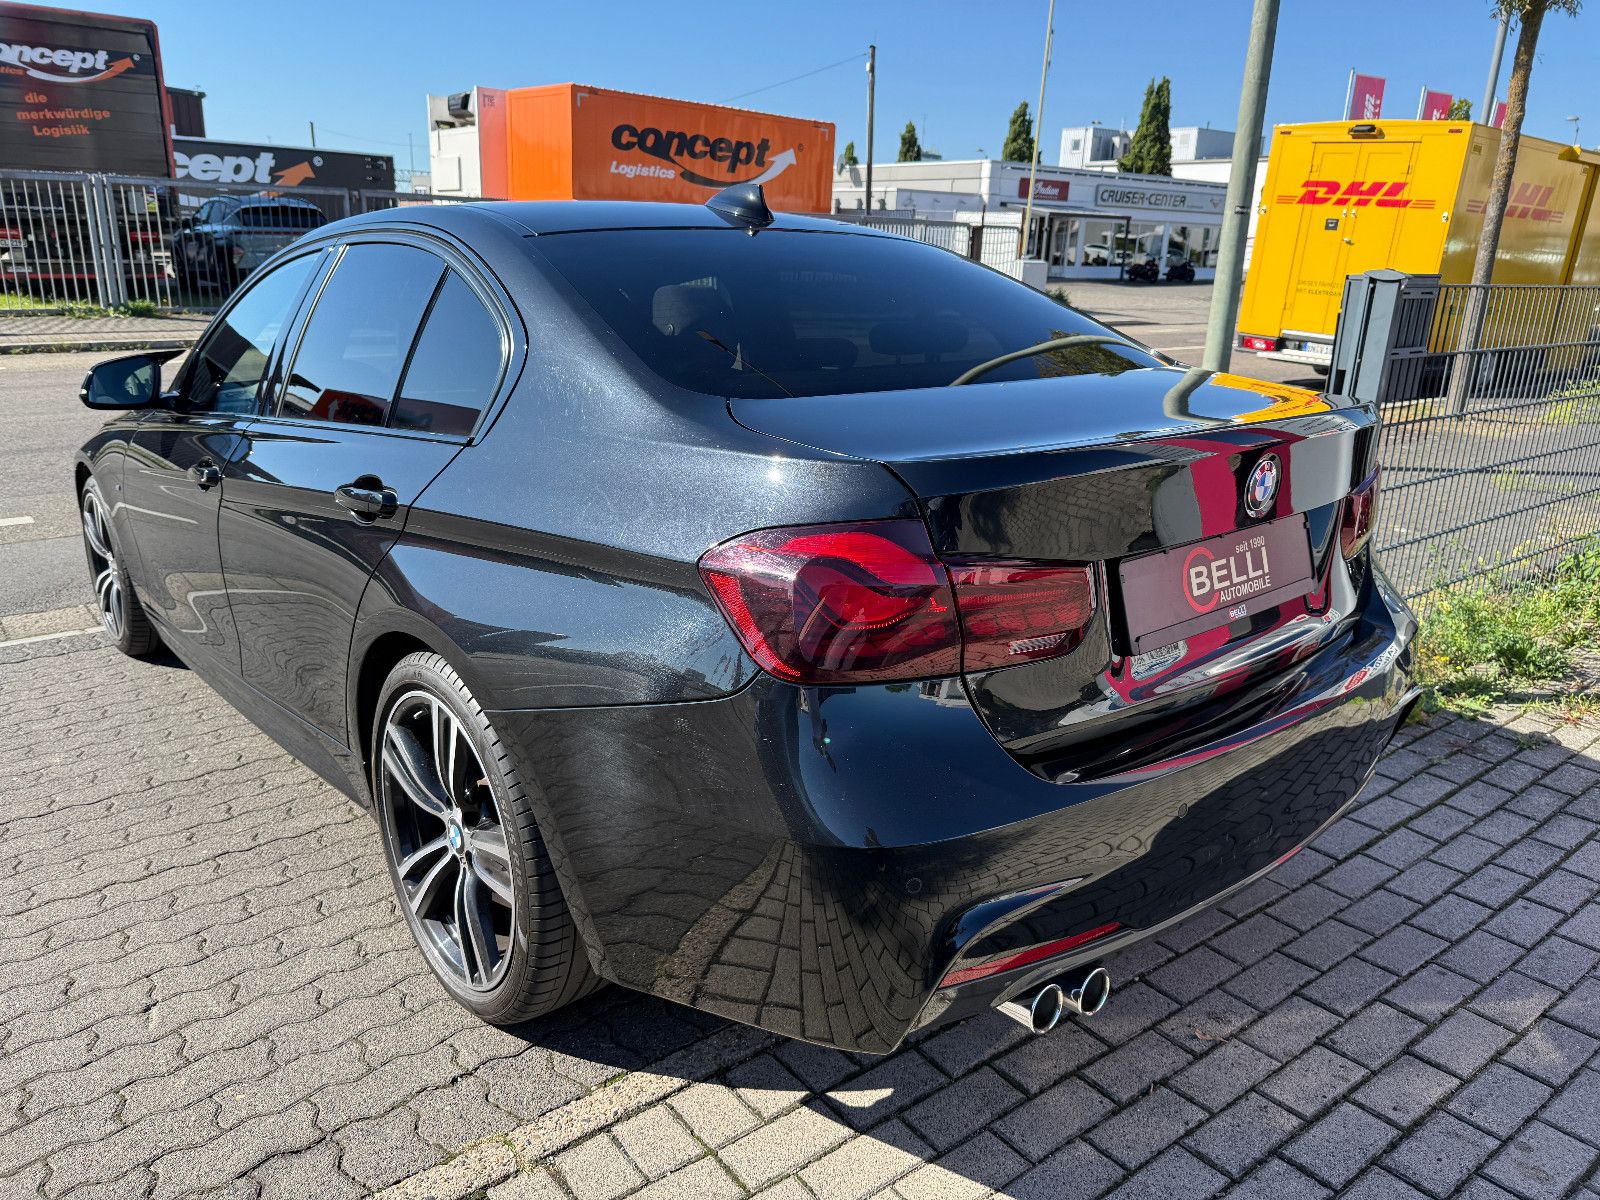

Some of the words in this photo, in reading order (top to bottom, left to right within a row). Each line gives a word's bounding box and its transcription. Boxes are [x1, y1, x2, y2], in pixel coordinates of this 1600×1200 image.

[24, 92, 47, 104] die
[16, 108, 112, 121] merkwürdige
[32, 125, 90, 138] Logistik
[611, 124, 770, 173] concept
[610, 160, 676, 179] Logistics
[1297, 180, 1411, 208] DHL
[1235, 541, 1249, 554] seit
[1249, 535, 1265, 550] 1990
[1189, 546, 1270, 597] BELLI
[1220, 575, 1271, 603] AUTOMOBILE
